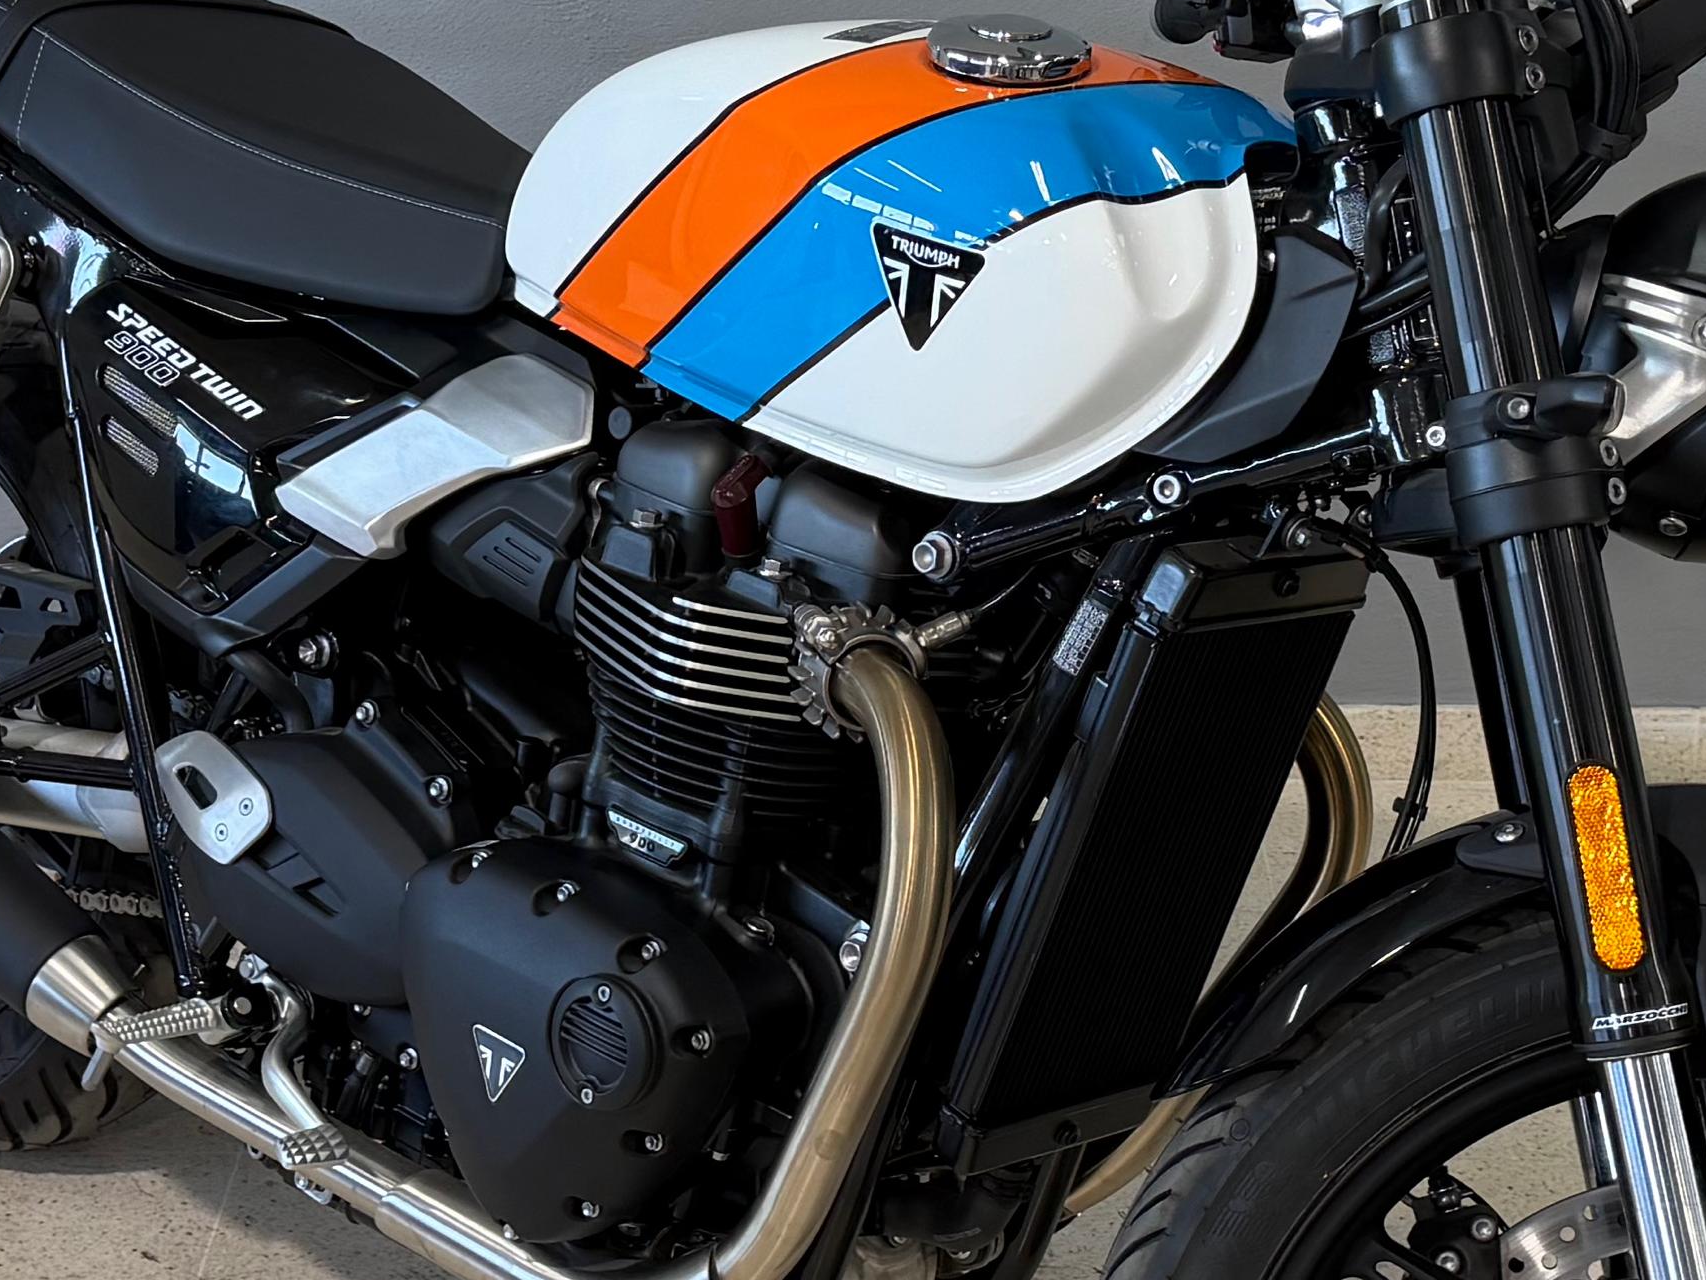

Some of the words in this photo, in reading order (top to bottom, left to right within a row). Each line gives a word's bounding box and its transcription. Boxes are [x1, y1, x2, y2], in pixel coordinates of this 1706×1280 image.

[891, 234, 961, 269] TRIUMPH
[104, 330, 181, 388] 900
[106, 303, 197, 369] SPEED
[190, 362, 265, 421] TWIN
[629, 831, 656, 853] 900
